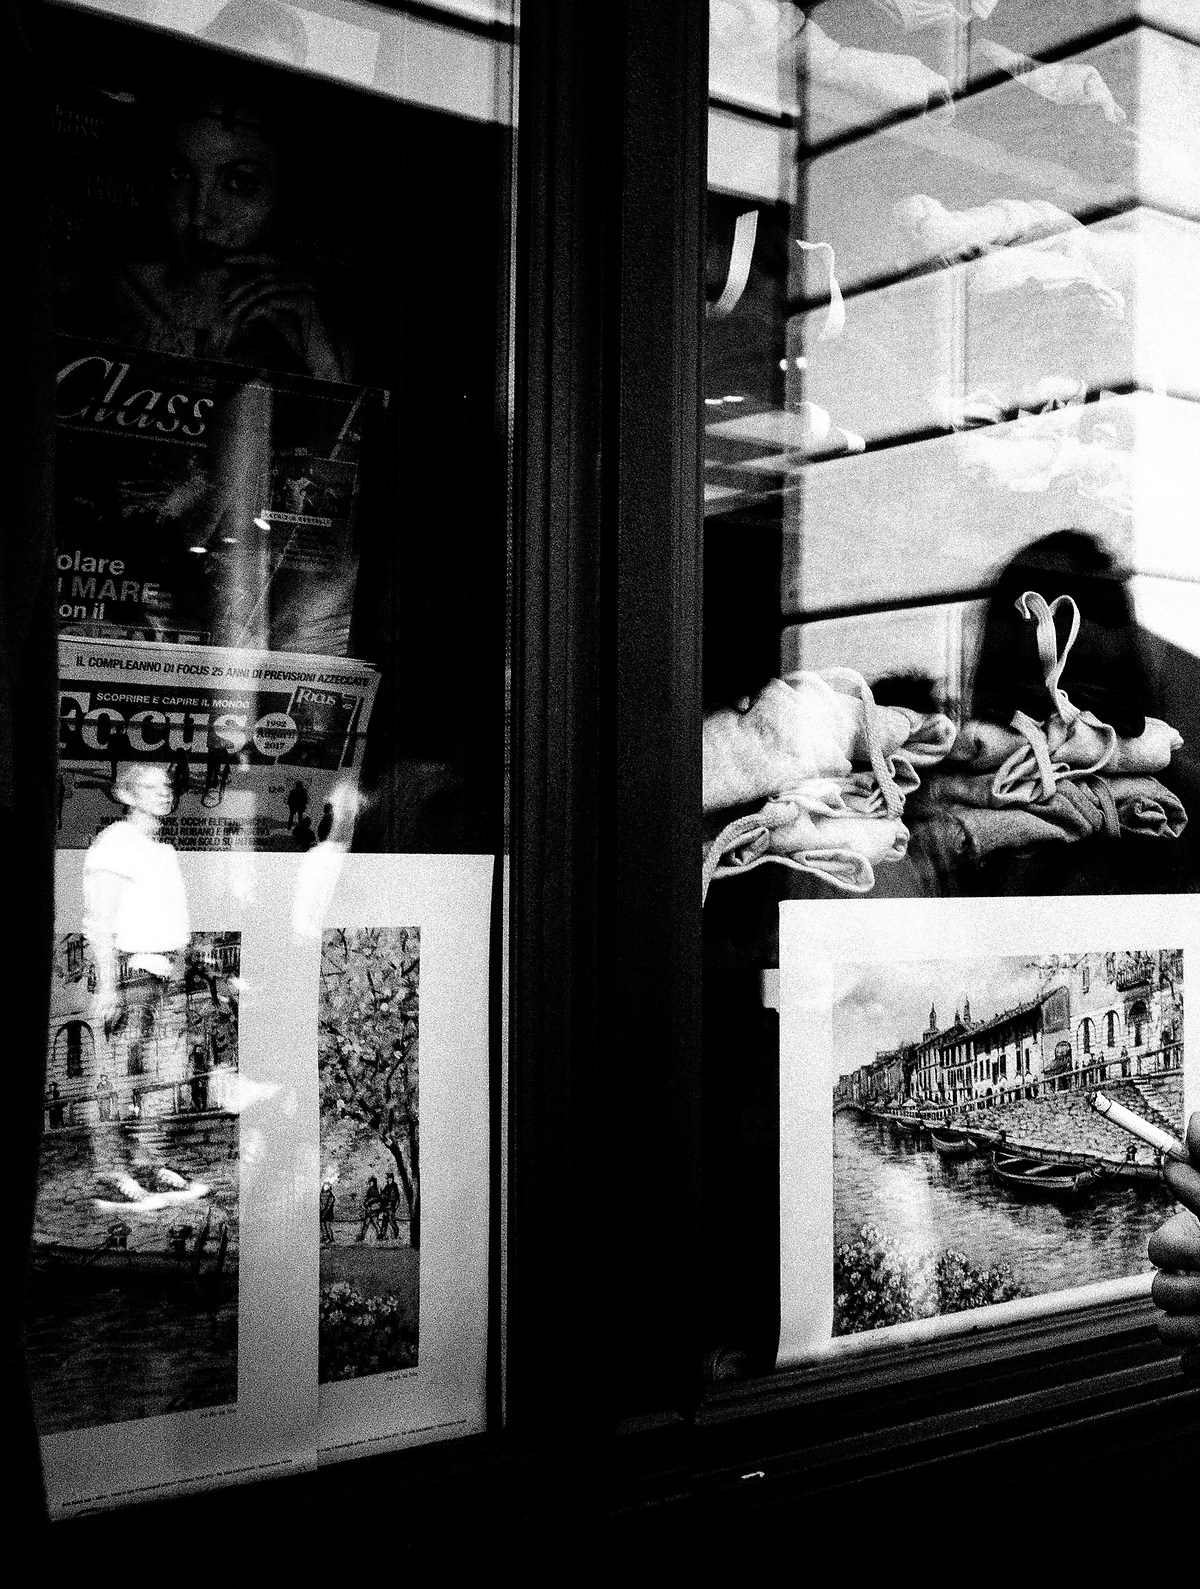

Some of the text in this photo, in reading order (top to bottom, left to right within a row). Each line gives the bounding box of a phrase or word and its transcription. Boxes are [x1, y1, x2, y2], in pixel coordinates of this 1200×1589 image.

[56, 355, 214, 437] Class
[56, 549, 126, 576] olare
[71, 575, 161, 605] MARE
[92, 601, 106, 621] il
[76, 656, 370, 687] IL COMPLEANNO DI FOCUS 25 ANNI DI PREVISIONI AZZECCATE
[96, 692, 250, 709] SCOPRIRE E CAPIRE IL MONDO
[296, 687, 336, 707] Focus
[57, 690, 247, 755] Focus
[265, 720, 288, 728] 1992
[264, 742, 286, 750] 2017
[180, 816, 207, 827] OCCHI
[178, 836, 197, 847] NON
[197, 837, 221, 847] SOLO
[180, 826, 214, 838] RUBANO
[215, 827, 222, 837] E
